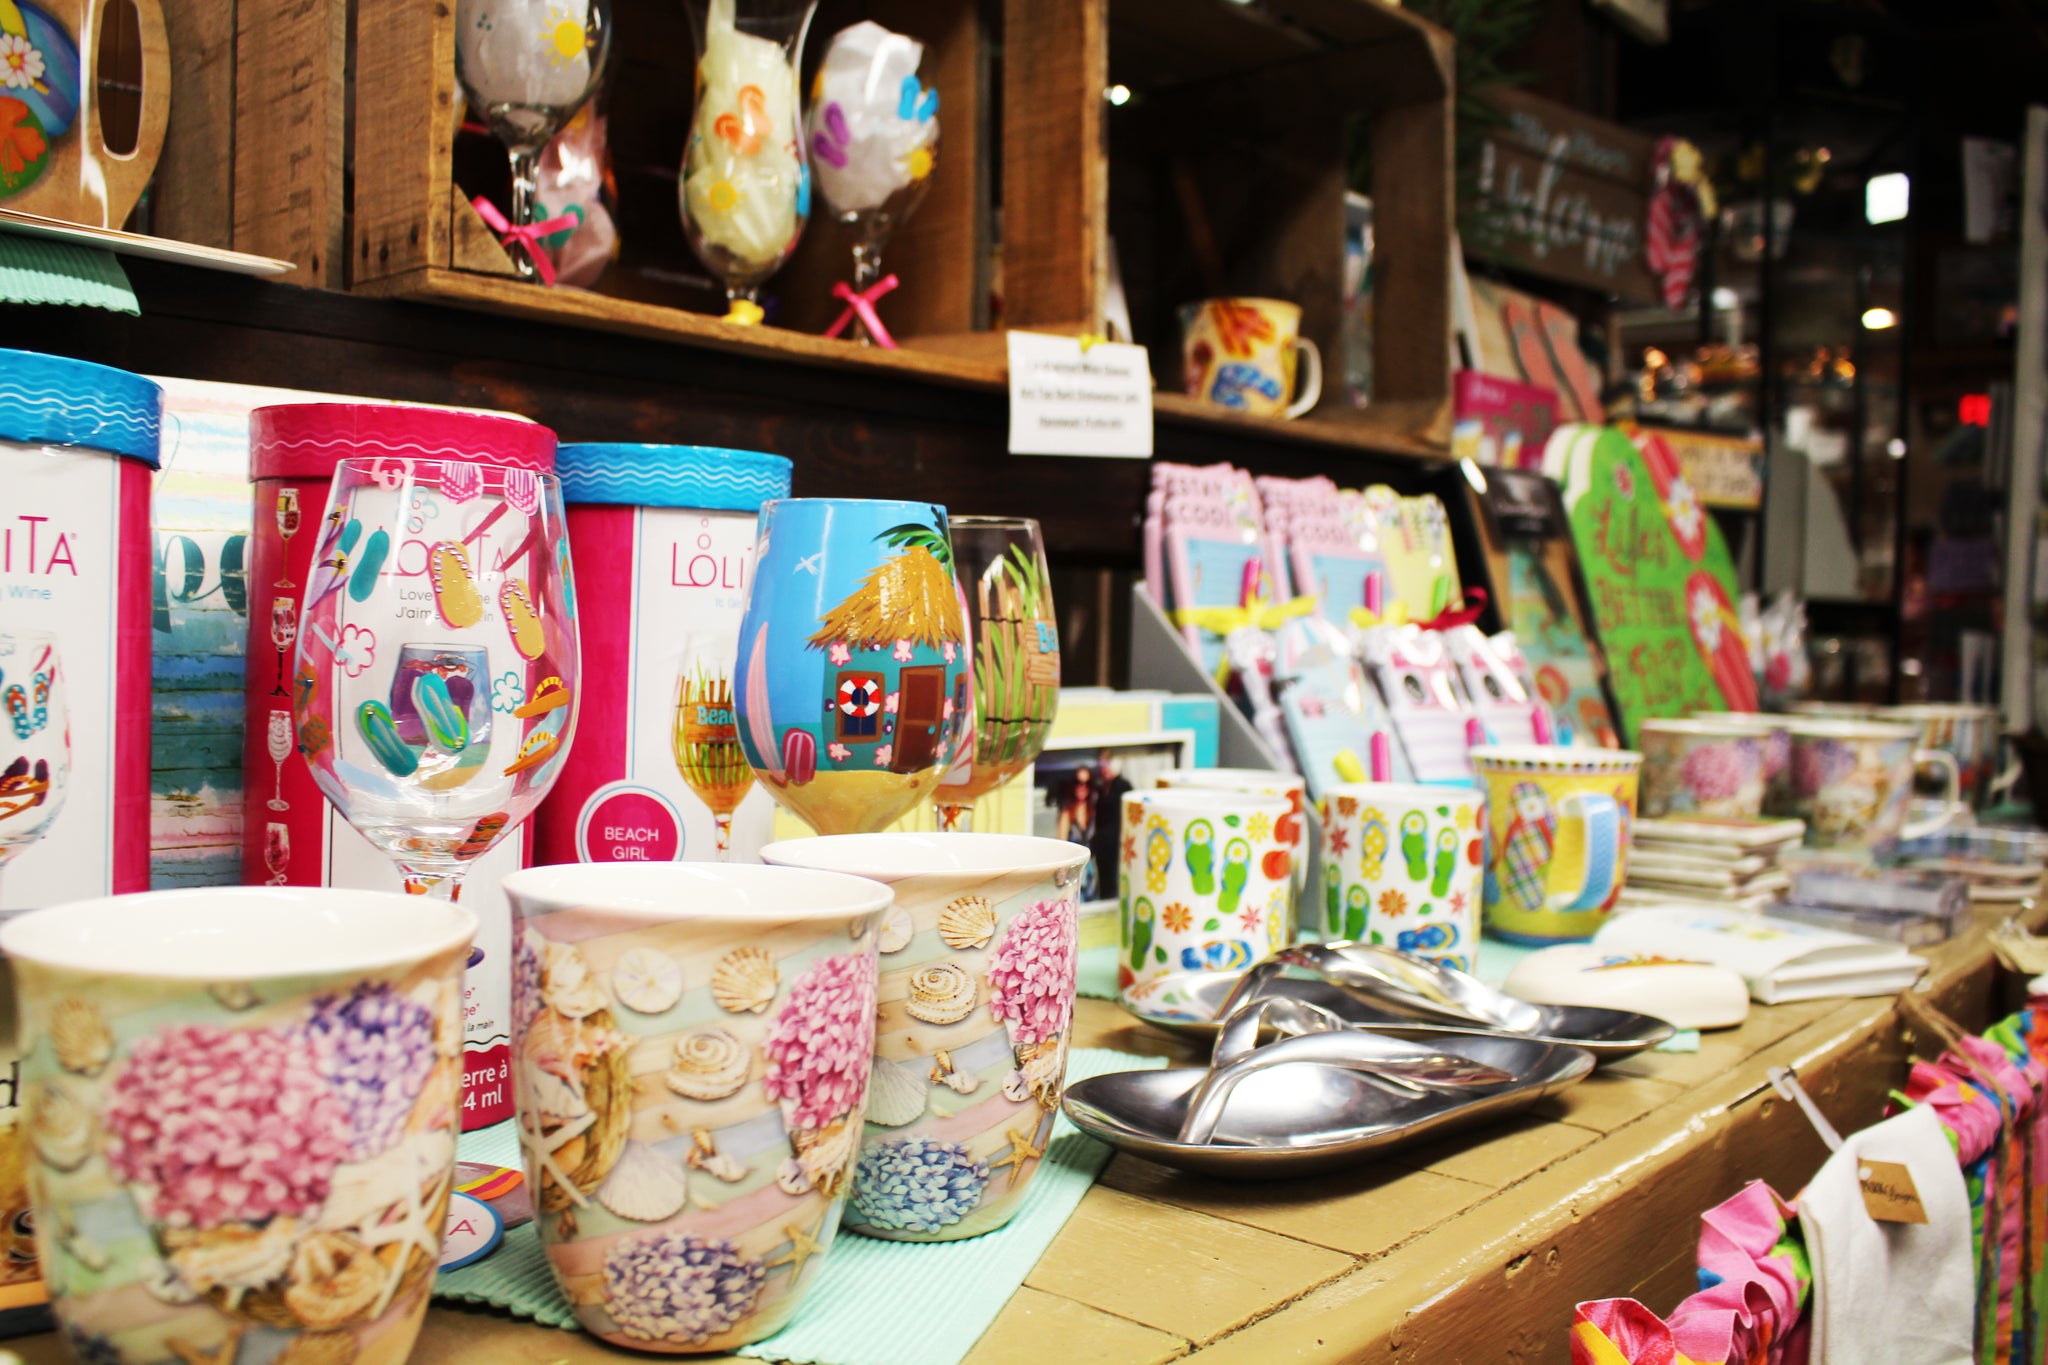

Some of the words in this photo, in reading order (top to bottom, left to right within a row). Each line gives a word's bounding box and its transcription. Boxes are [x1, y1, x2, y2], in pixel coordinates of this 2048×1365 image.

[671, 541, 745, 589] LOLI
[400, 588, 433, 601] Love
[697, 705, 735, 726] Beac
[604, 827, 659, 842] BEACH
[612, 845, 650, 861] GIRL
[461, 1067, 496, 1088] erre
[481, 1083, 502, 1108] ml
